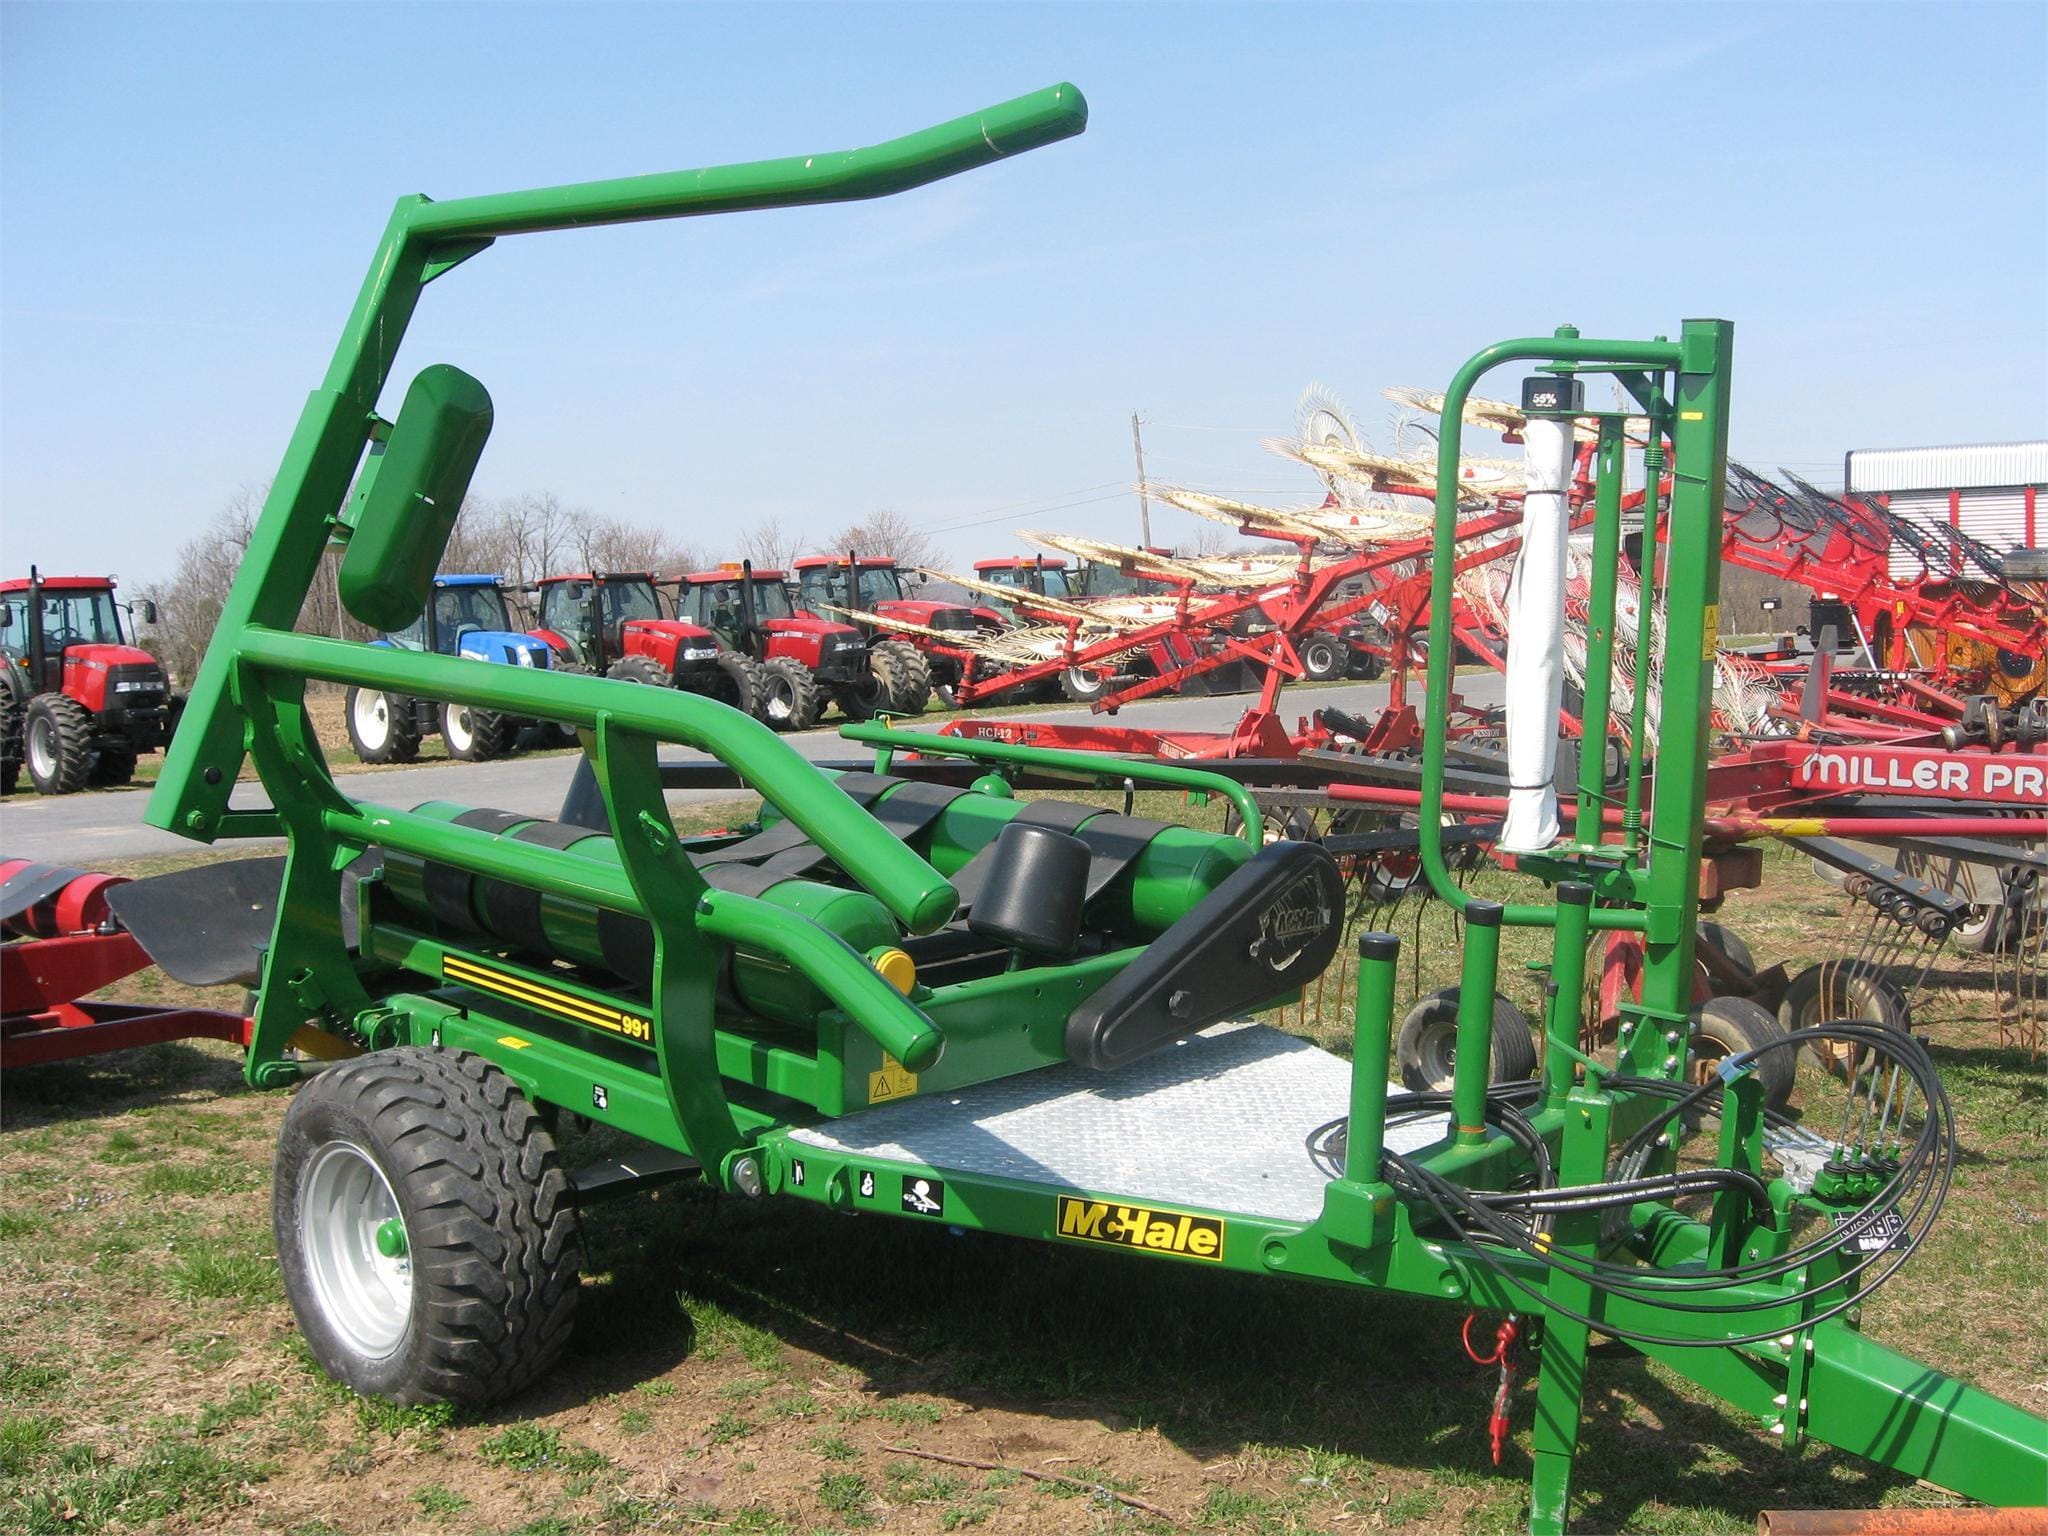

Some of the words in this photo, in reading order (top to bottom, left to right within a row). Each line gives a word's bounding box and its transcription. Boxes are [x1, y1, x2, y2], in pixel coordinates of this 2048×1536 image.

[1532, 392, 1557, 405] 55%
[1802, 752, 1969, 792] MILLER
[1983, 764, 2048, 797] PR
[622, 1015, 649, 1041] 991
[1062, 1200, 1218, 1255] McHale
